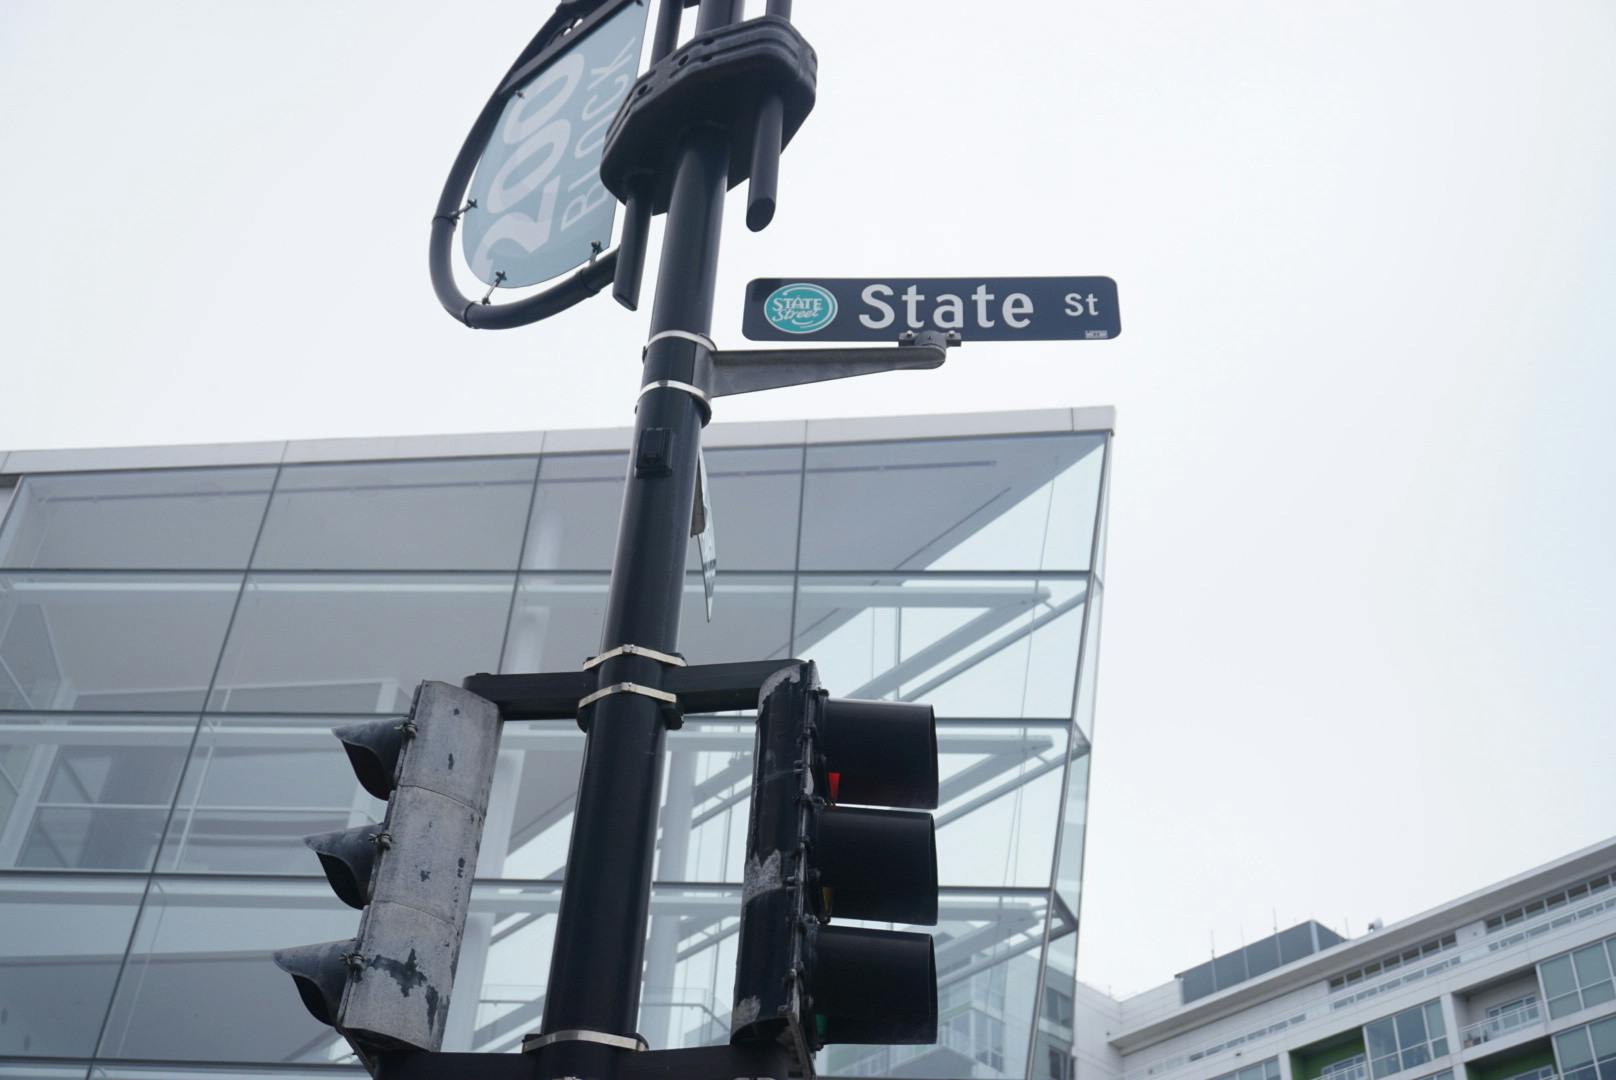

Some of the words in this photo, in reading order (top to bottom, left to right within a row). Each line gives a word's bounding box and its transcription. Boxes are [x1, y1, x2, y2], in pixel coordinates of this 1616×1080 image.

[472, 52, 584, 279] 200
[772, 295, 823, 311] STATE
[772, 308, 818, 321] Street
[859, 283, 1033, 328] State
[1064, 292, 1099, 316] St
